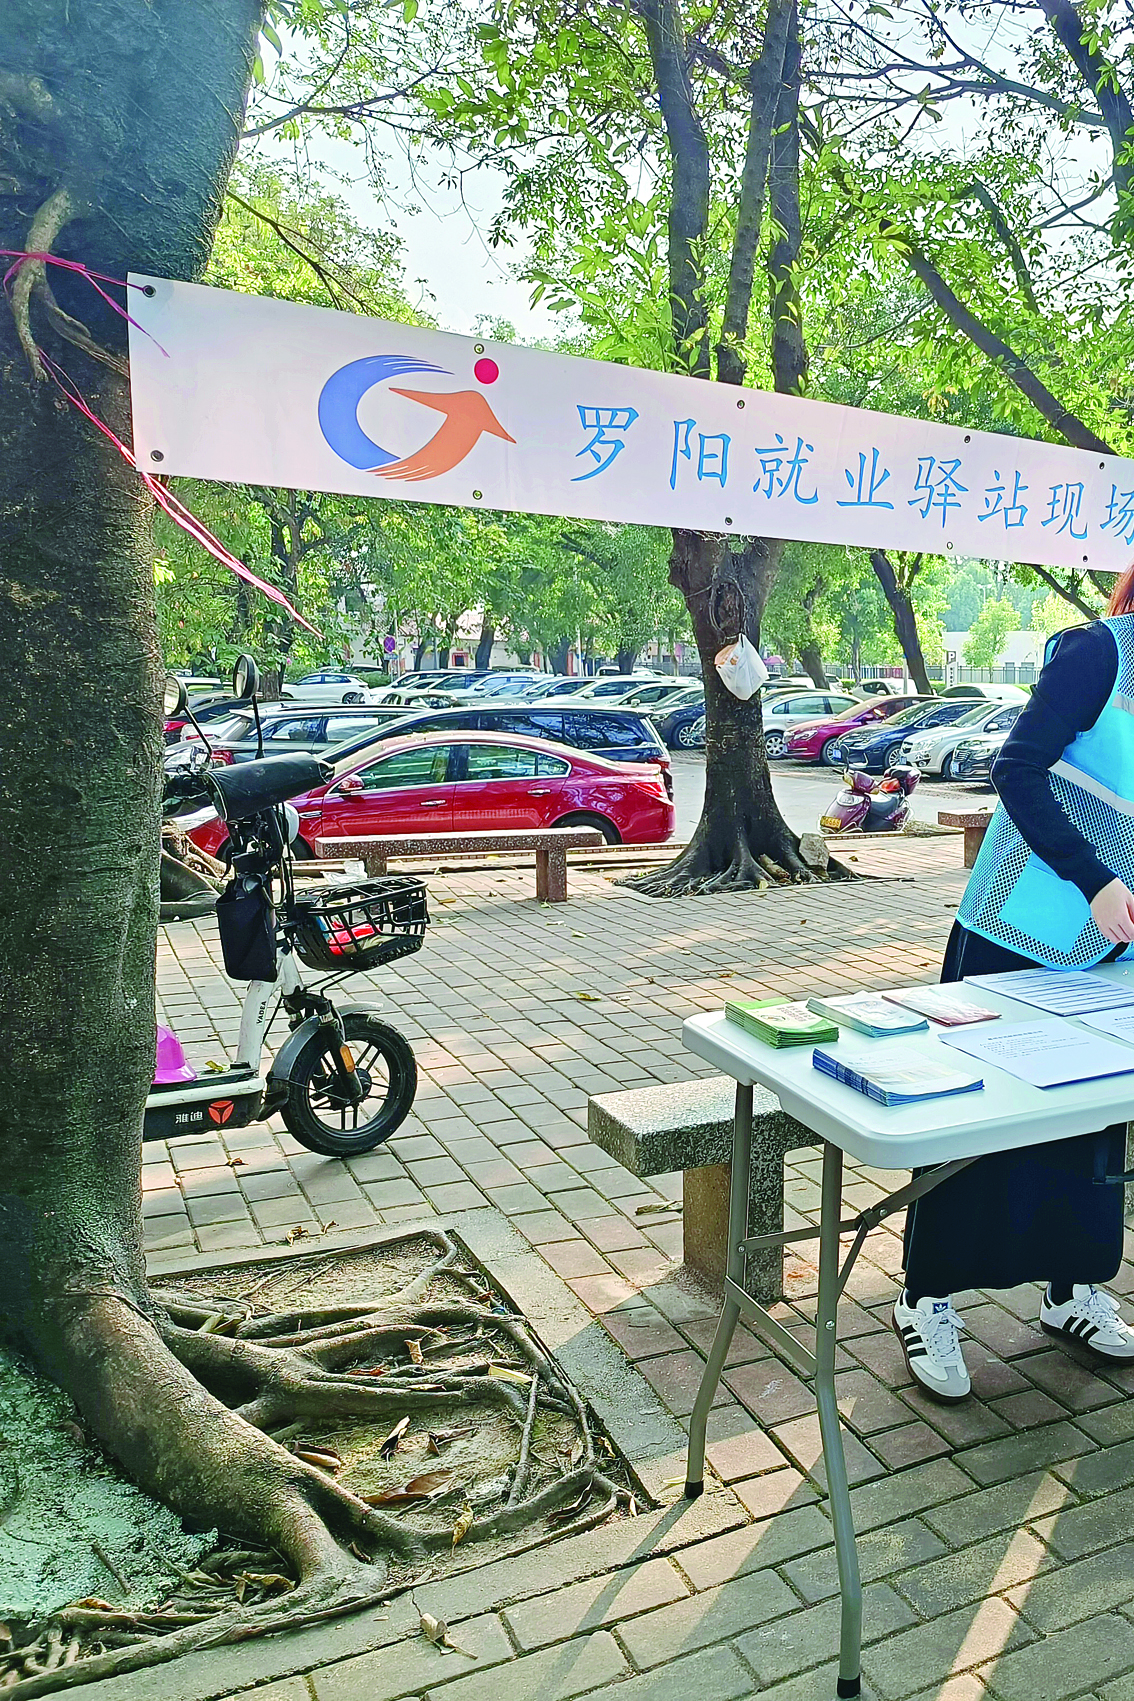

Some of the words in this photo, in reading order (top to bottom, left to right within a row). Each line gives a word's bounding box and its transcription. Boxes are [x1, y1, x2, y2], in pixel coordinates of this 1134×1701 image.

[948, 652, 956, 662] P
[256, 1001, 267, 1025] YADEA
[175, 1111, 203, 1124] 雅迪
